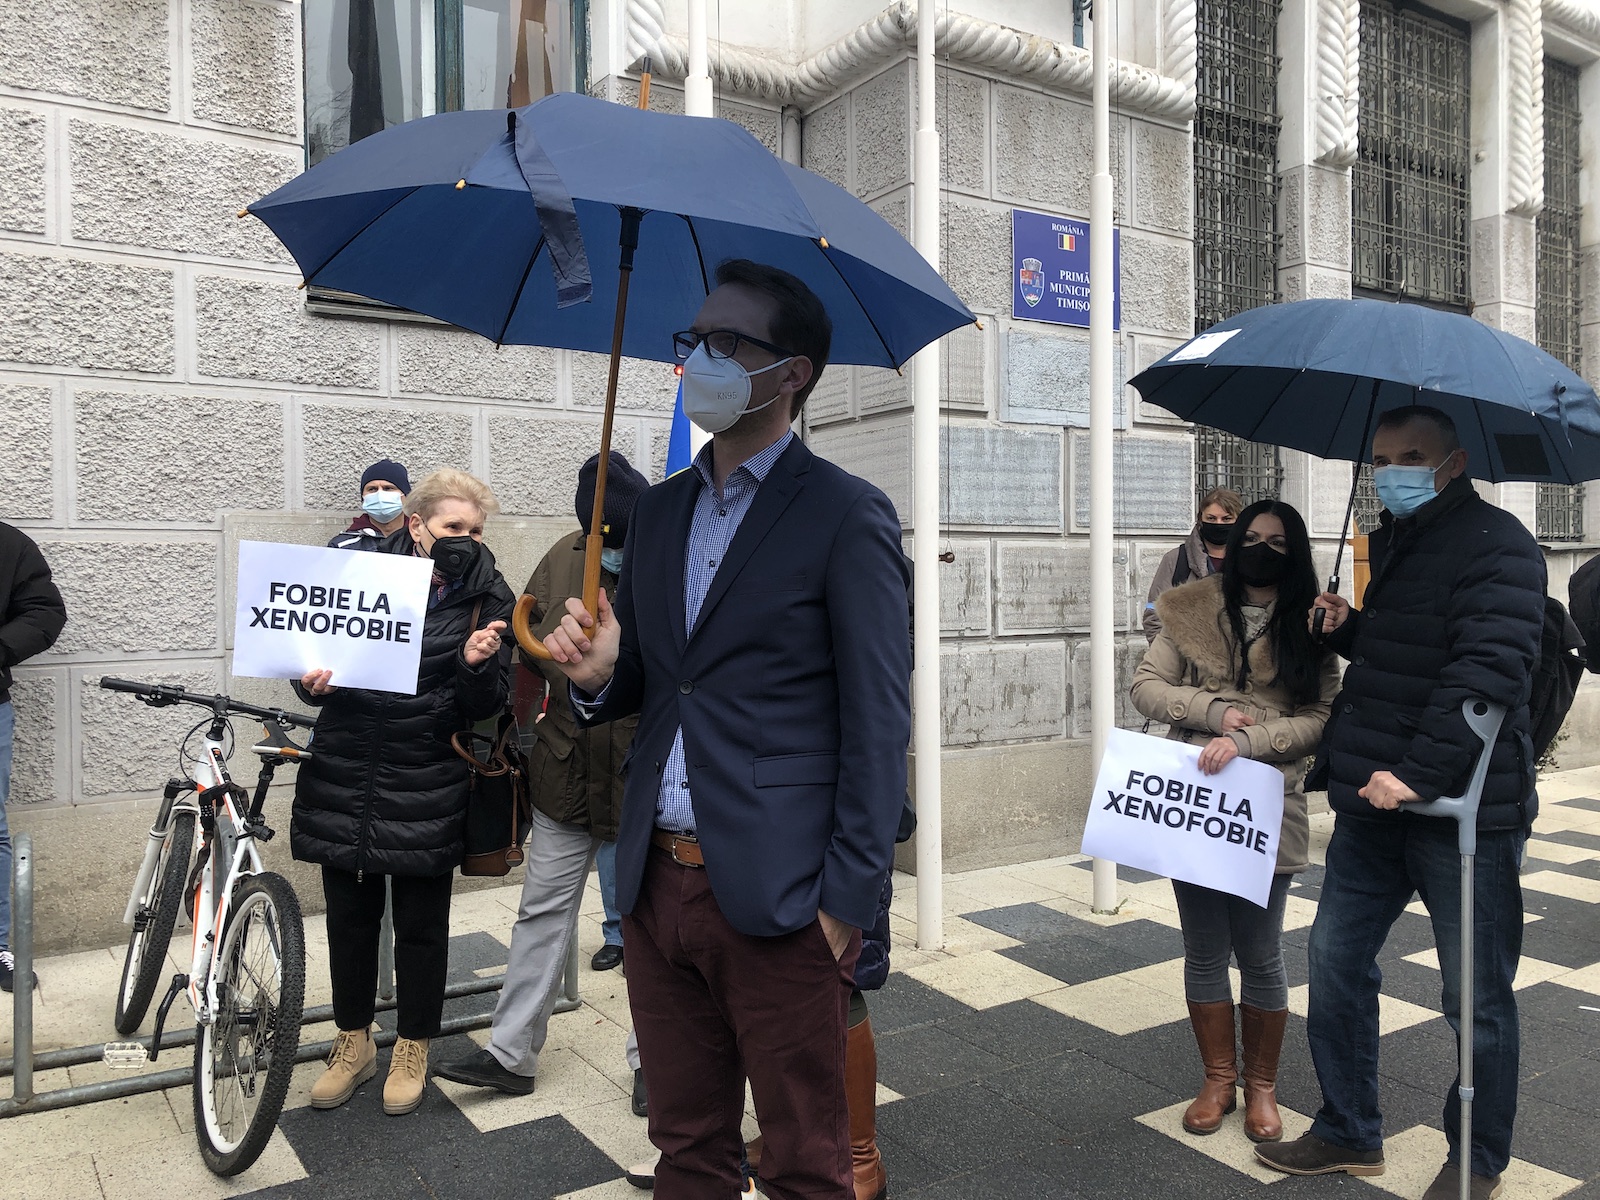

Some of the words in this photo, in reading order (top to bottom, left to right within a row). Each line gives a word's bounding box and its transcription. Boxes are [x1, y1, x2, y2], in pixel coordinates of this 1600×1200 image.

[1051, 222, 1084, 236] ROMÂNIA
[1060, 269, 1090, 284] PRIMĂ
[1049, 282, 1090, 297] MUNICIP
[1056, 297, 1090, 312] TIMIȘO
[717, 391, 738, 400] KN95
[269, 582, 352, 610] FOBIE
[357, 591, 391, 615] LA
[249, 606, 411, 643] XENOFOBIE
[1126, 770, 1212, 809] FOBIE
[1217, 792, 1253, 822] LA
[1103, 790, 1269, 855] XENOFOBIE
